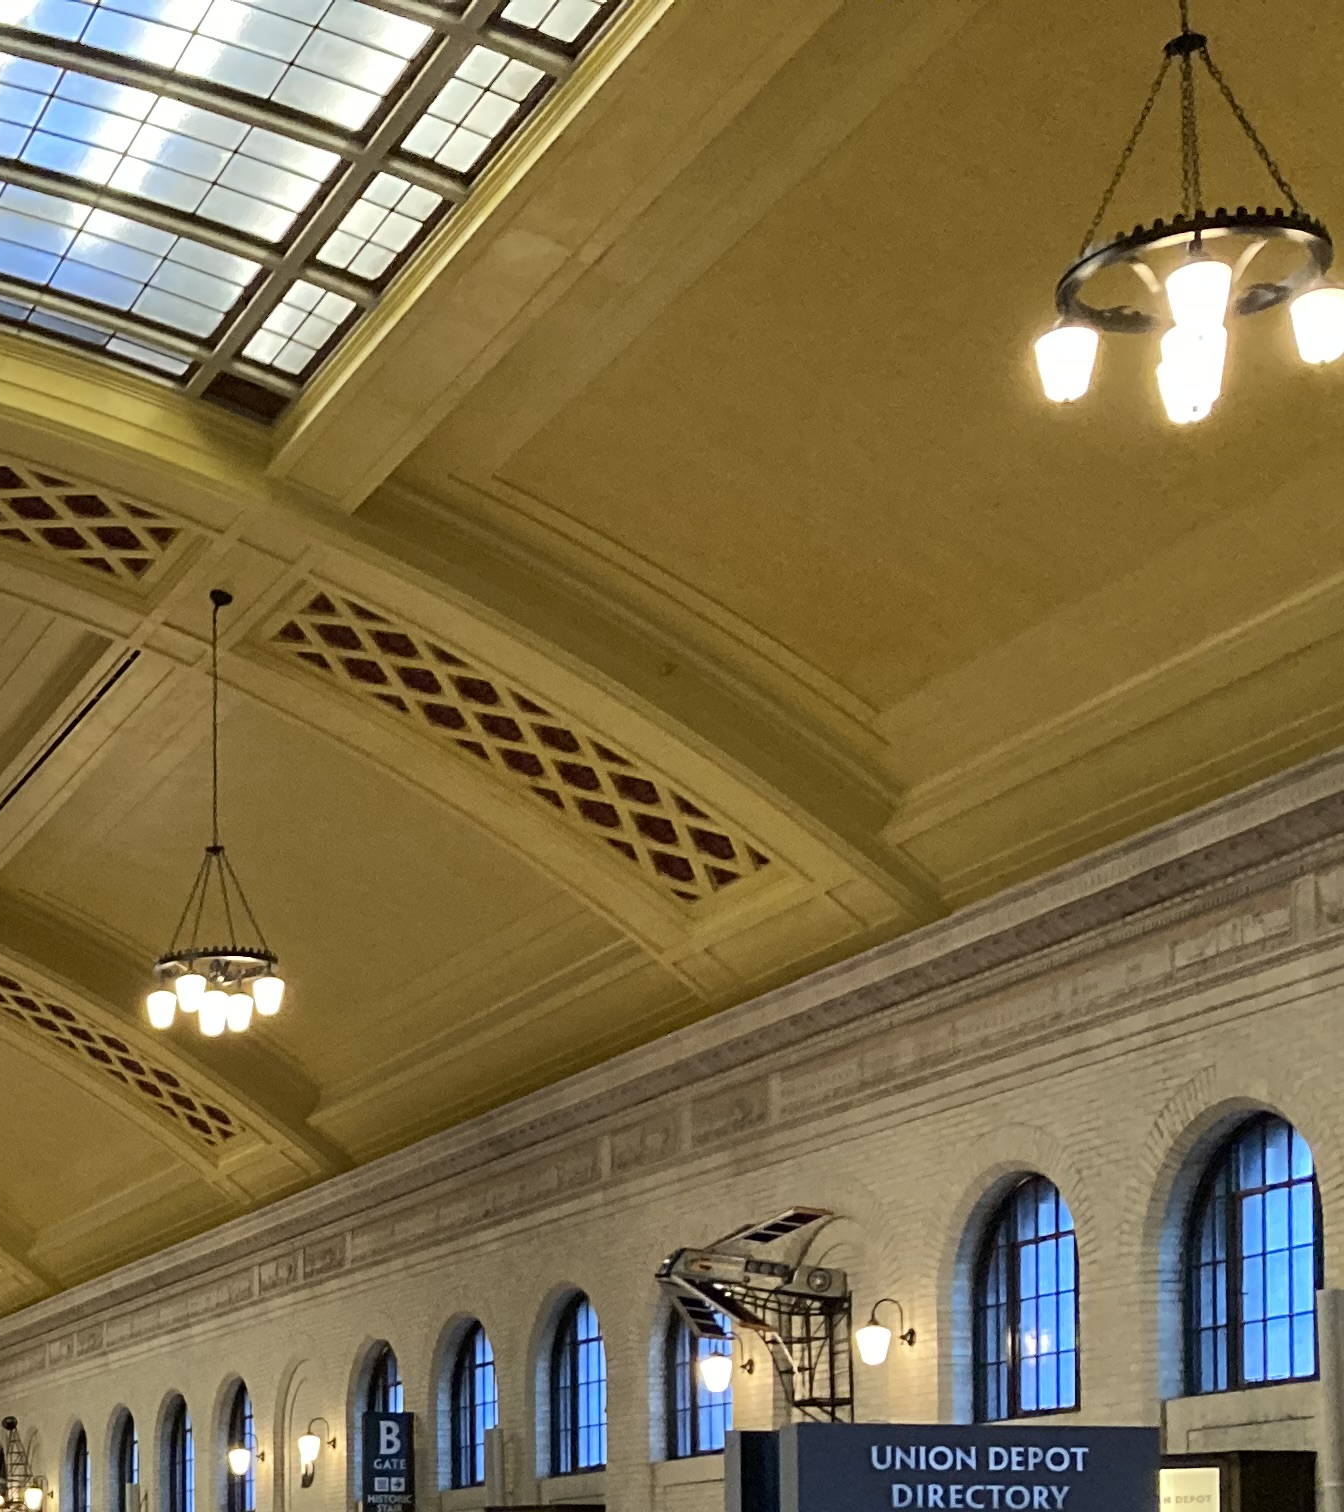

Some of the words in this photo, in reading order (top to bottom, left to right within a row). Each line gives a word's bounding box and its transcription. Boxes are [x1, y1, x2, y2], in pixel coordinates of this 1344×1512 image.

[379, 1420, 401, 1454] B
[373, 1459, 407, 1470] GATE
[870, 1445, 977, 1471] UNION
[988, 1446, 1090, 1472] DEPOT
[891, 1483, 1071, 1510] DIRECTORY
[1175, 1494, 1212, 1504] DEPOT
